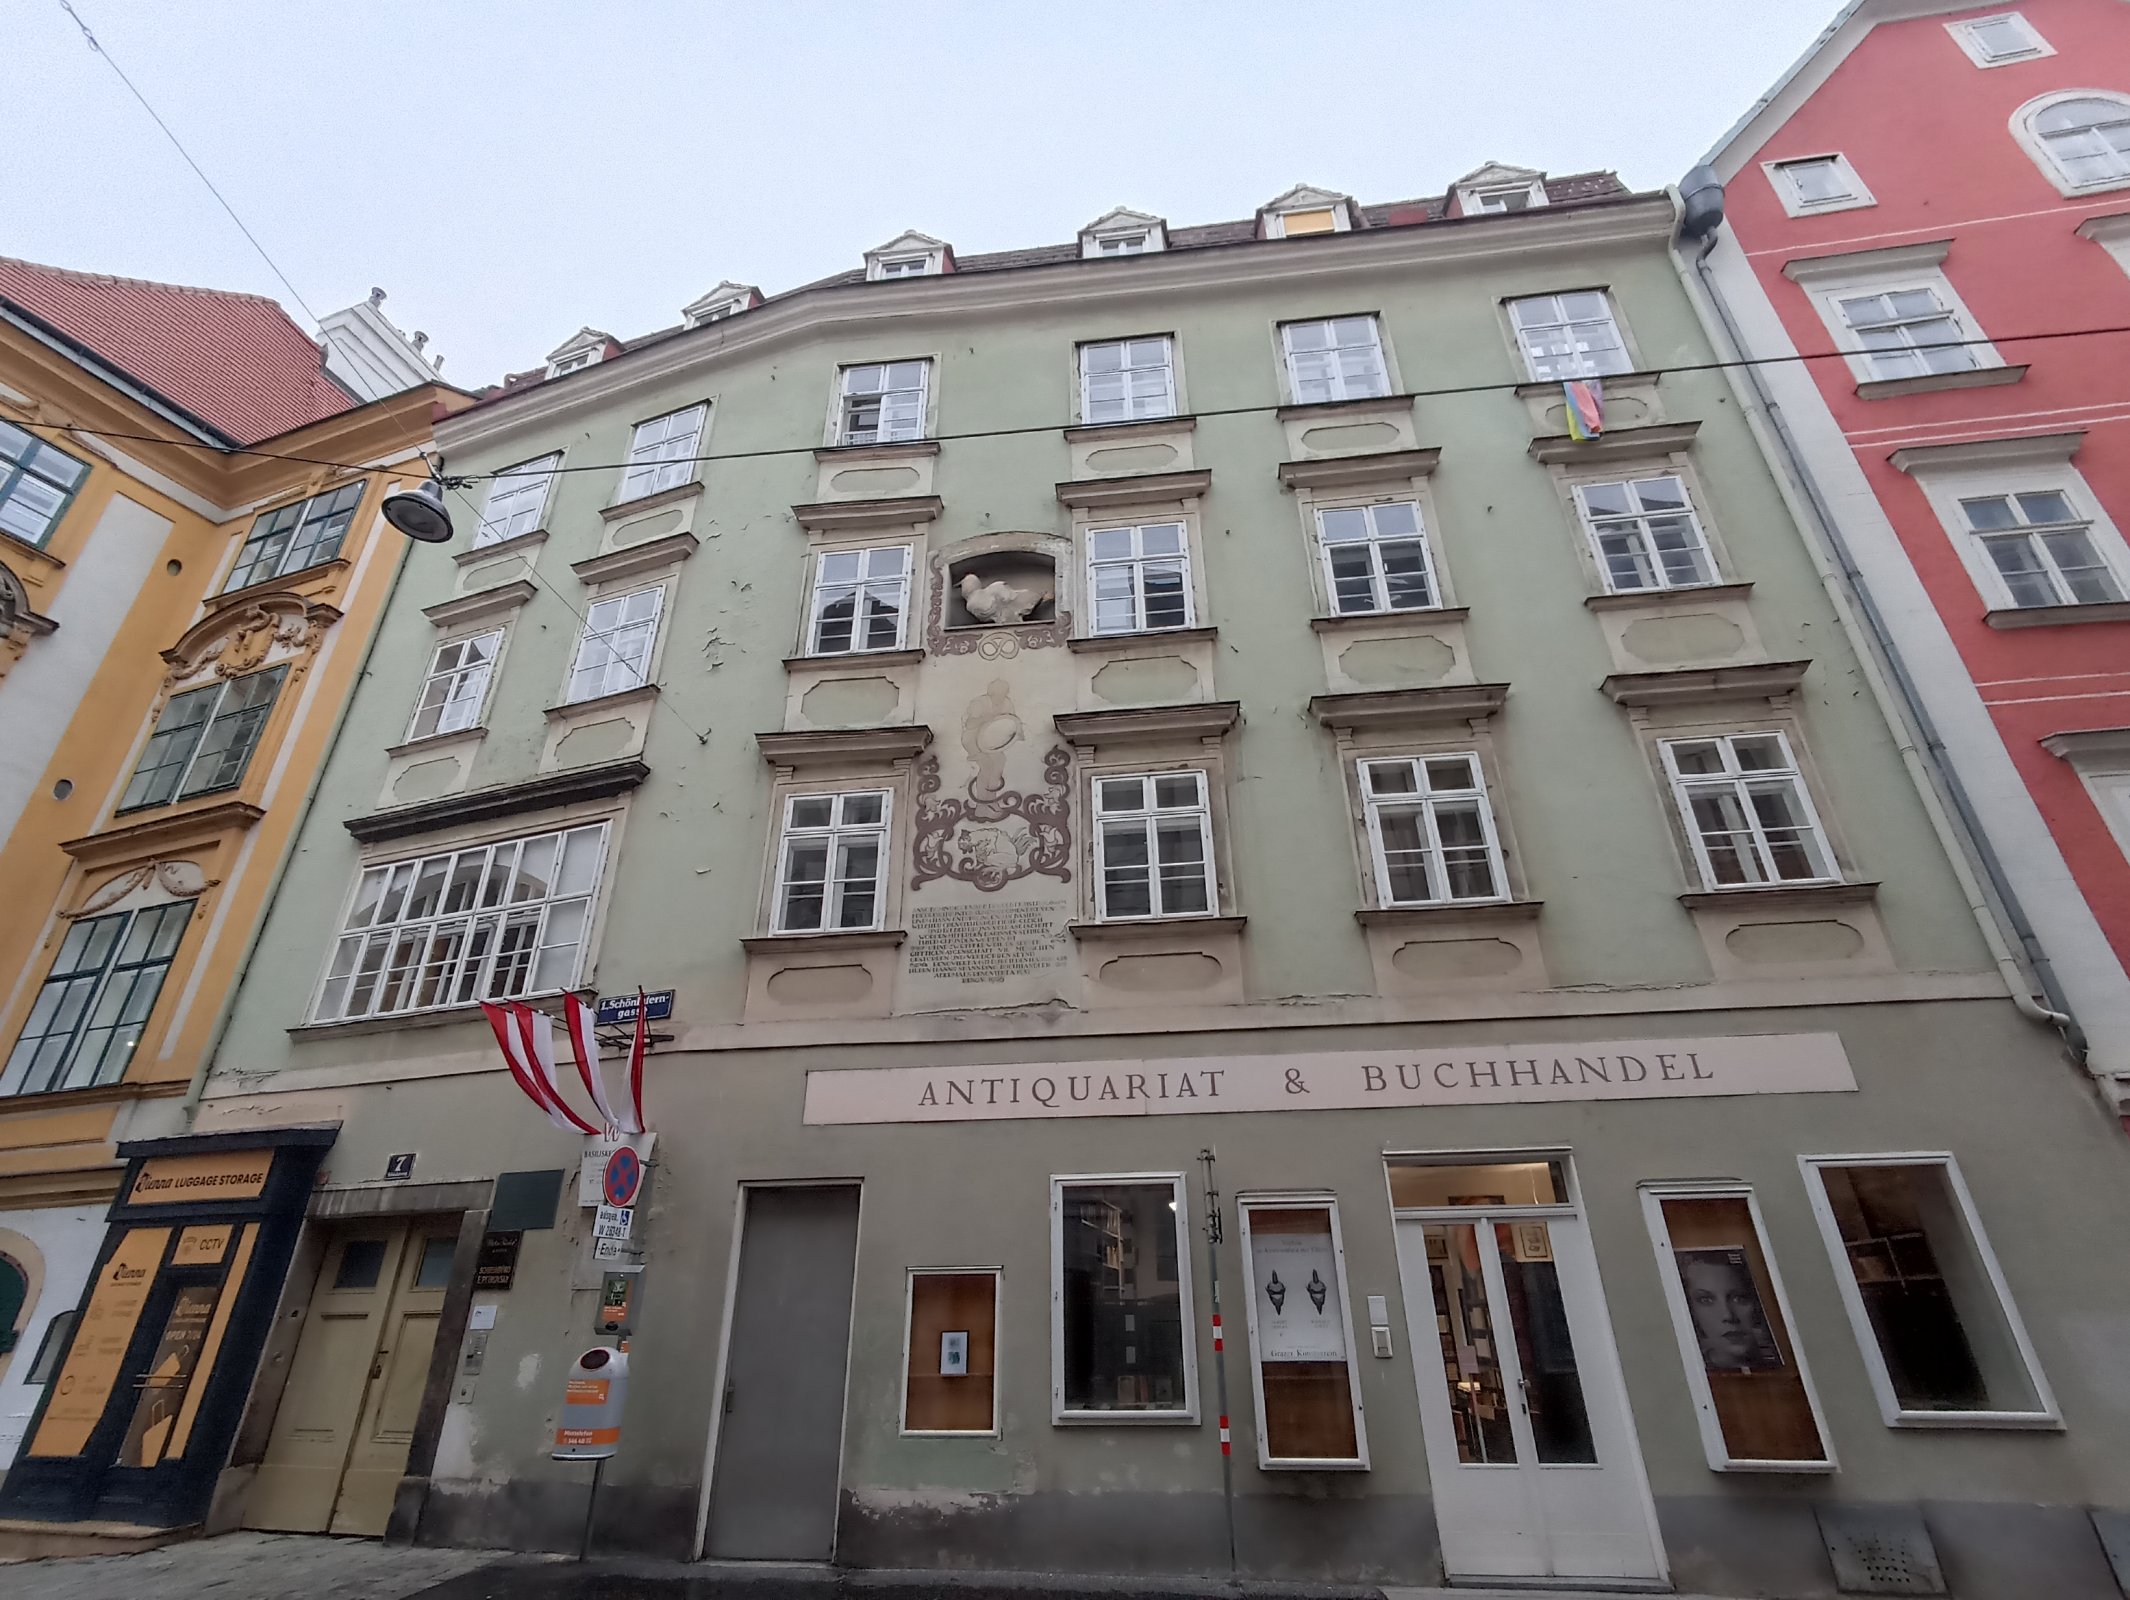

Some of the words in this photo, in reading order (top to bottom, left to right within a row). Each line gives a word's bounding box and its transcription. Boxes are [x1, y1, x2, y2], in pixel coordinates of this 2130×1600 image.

[609, 995, 669, 1010] Schönltern-
[617, 1006, 648, 1020] gass
[918, 1069, 1225, 1107] ANTIQUARIAT
[1285, 1067, 1310, 1095] &
[1361, 1052, 1714, 1092] BUCHHANDEL
[395, 1156, 407, 1171] 7
[134, 1172, 174, 1193] Vienna
[174, 1175, 218, 1188] LUGGAGE
[219, 1173, 263, 1186] STORAGE
[200, 1238, 225, 1250] CCTV
